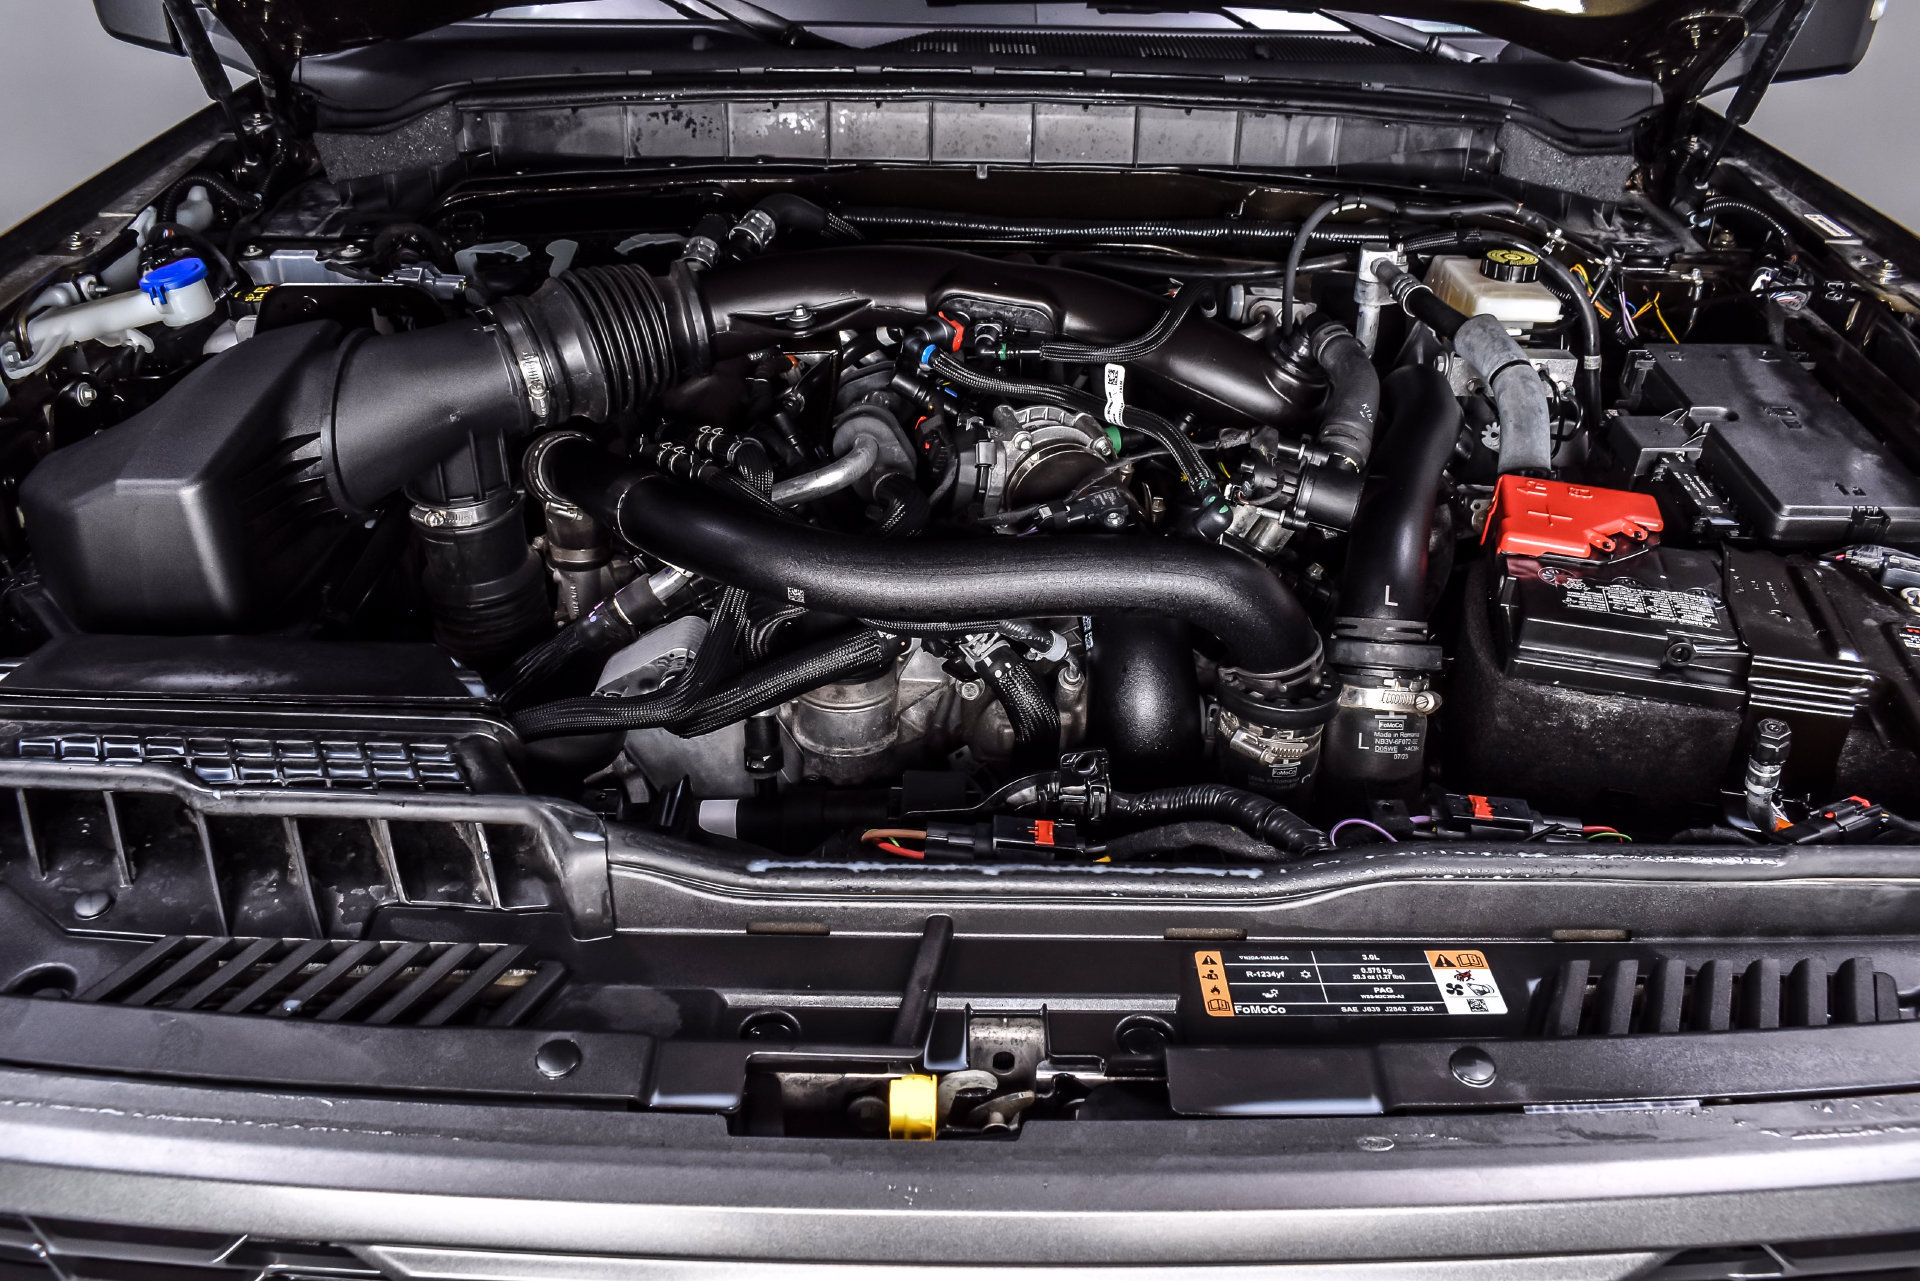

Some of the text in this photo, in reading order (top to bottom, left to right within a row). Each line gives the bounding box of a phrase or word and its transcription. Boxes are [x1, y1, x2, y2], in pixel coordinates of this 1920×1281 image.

[1385, 585, 1398, 606] L
[1358, 732, 1369, 749] L
[1245, 970, 1285, 979] R-1234yf
[1382, 967, 1393, 975] kg
[1373, 986, 1394, 994] PAG
[1234, 1005, 1287, 1014] FoMoCo
